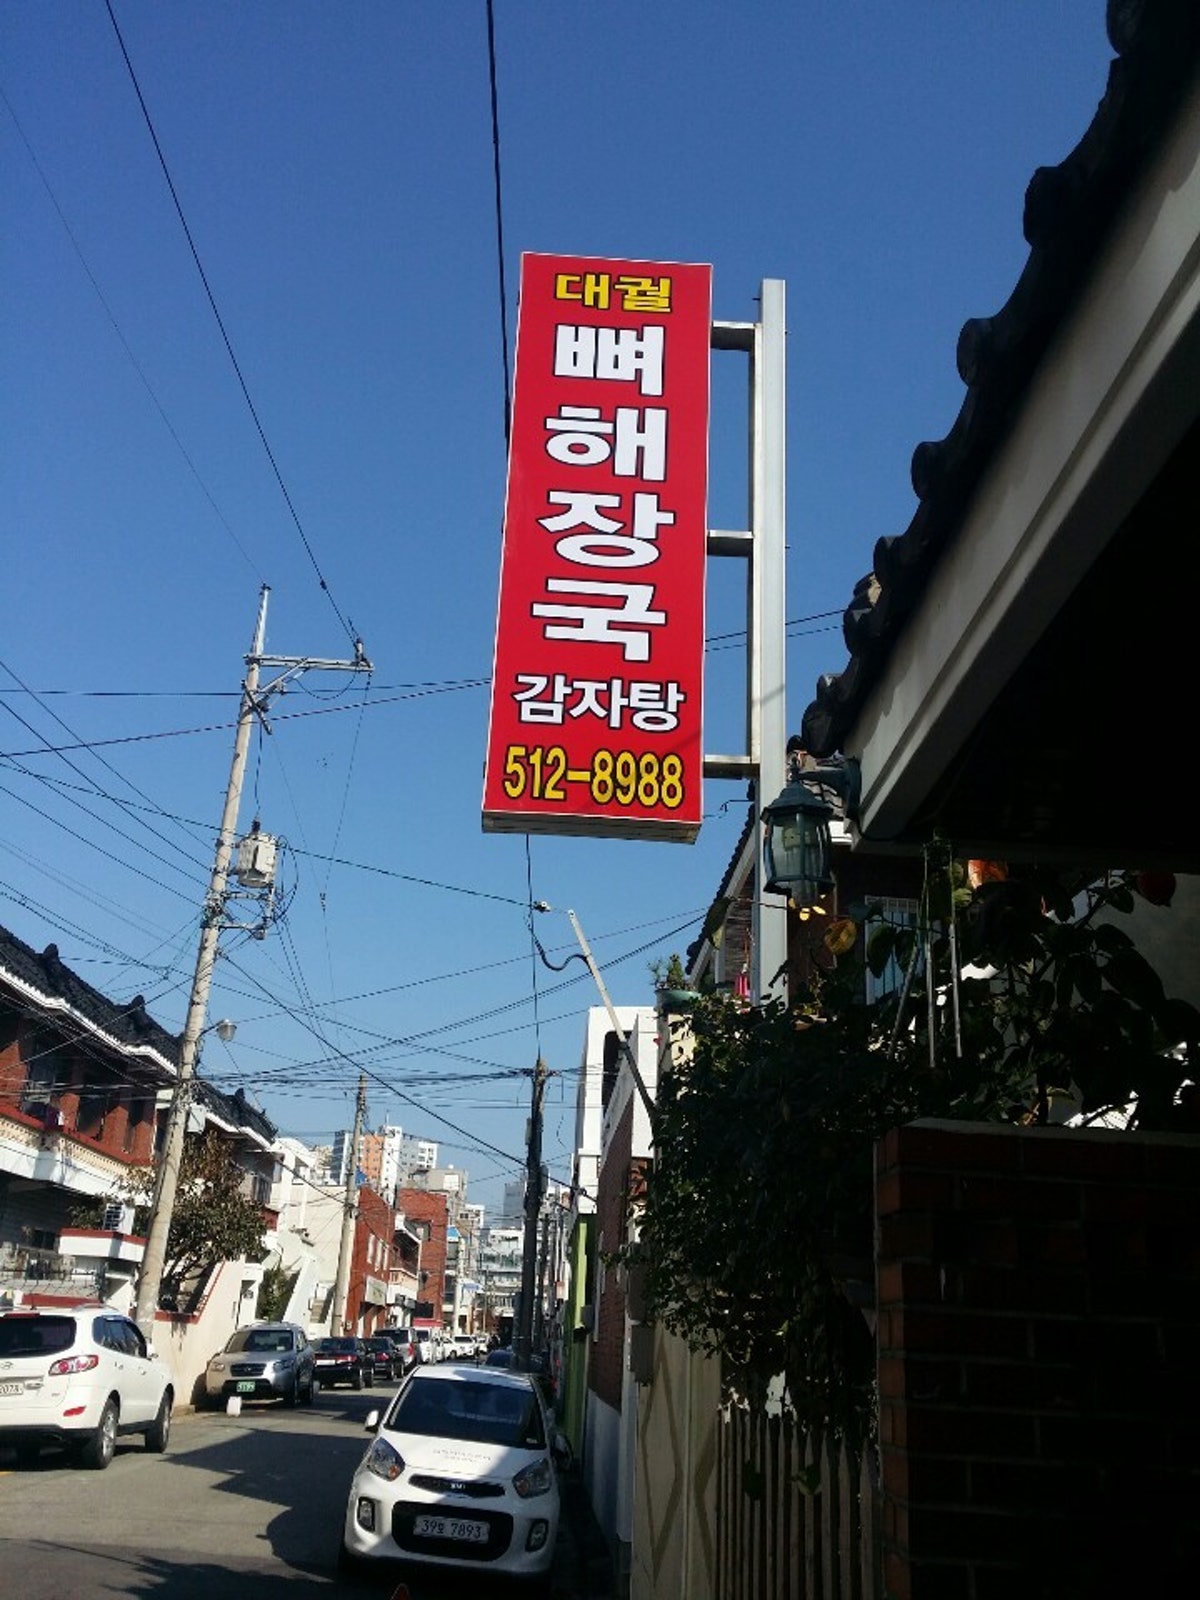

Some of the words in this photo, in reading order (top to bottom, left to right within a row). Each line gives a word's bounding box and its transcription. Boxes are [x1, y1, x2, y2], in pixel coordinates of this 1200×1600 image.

[555, 273, 672, 314] 대궐
[532, 323, 674, 662] 뼈해장국
[512, 674, 686, 732] 감자탕
[503, 745, 684, 808] 512-8988
[450, 1522, 482, 1538] 7893
